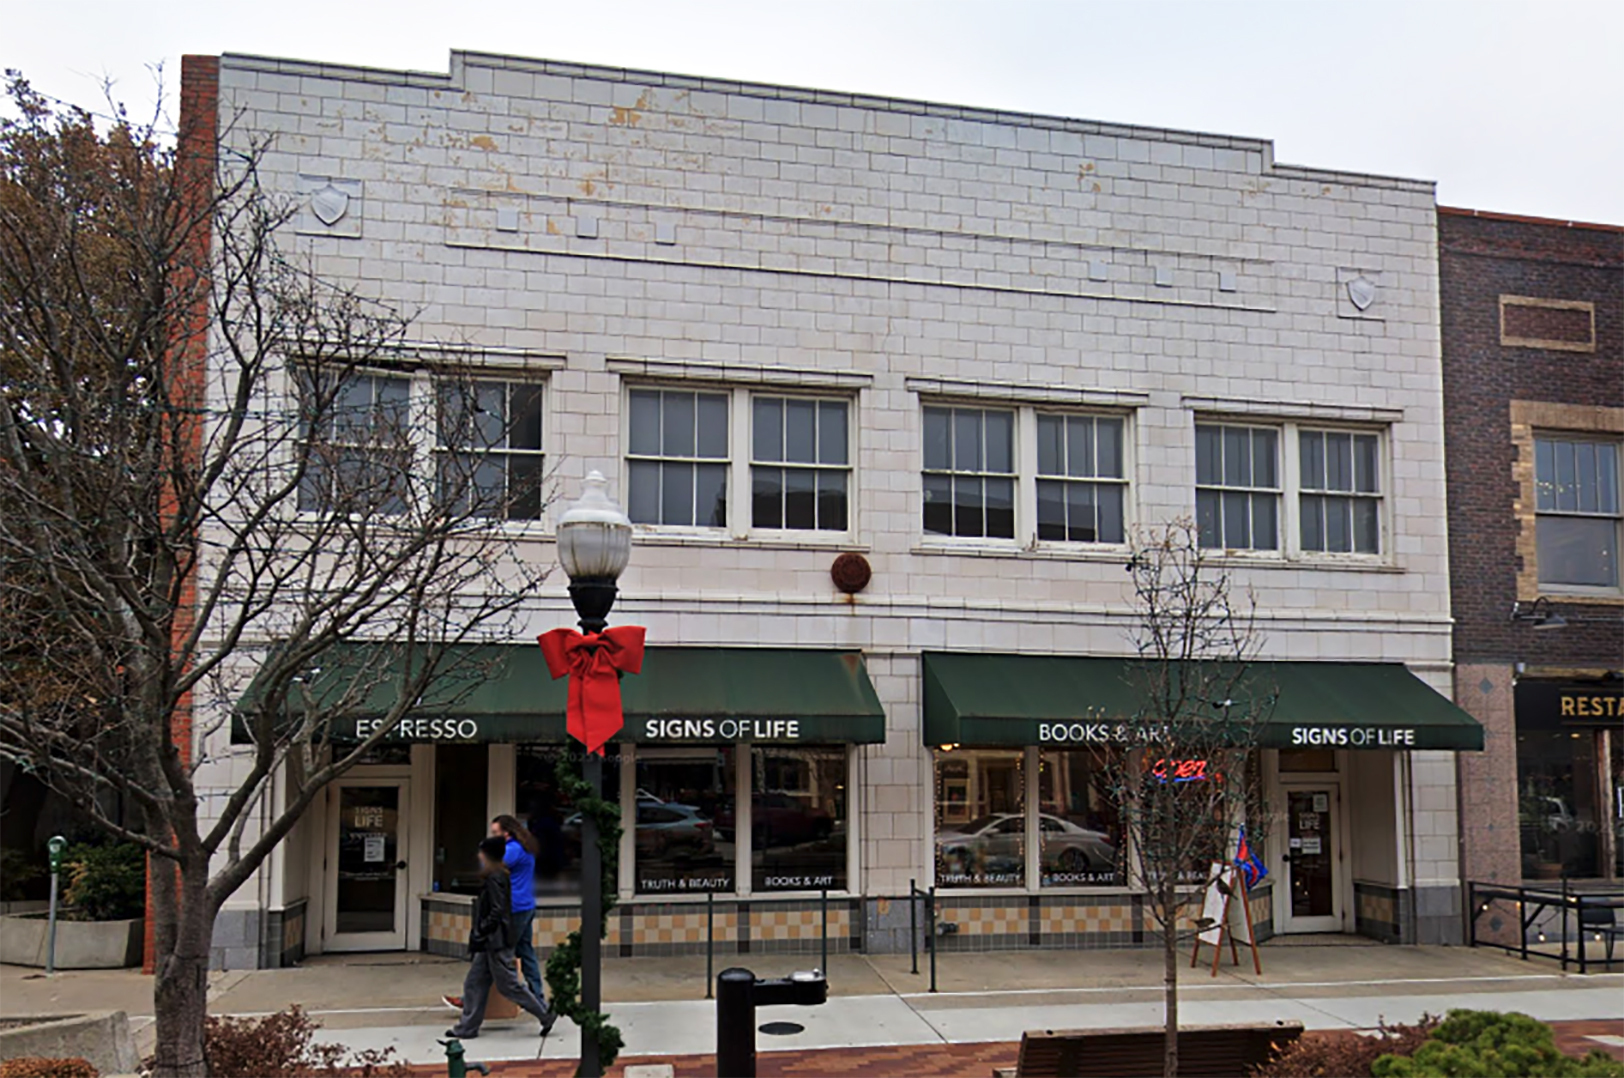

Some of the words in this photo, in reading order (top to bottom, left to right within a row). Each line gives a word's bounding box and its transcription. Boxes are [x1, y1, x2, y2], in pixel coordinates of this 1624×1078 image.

[645, 719, 715, 738] SIGNS
[719, 719, 751, 738] OF
[754, 720, 800, 738] LIFE
[1039, 724, 1110, 743] BOOKS
[1112, 724, 1128, 742] &
[1292, 727, 1347, 745] SIGNS
[1351, 728, 1375, 745] OF
[1378, 728, 1415, 745] LIFE
[354, 815, 383, 828] LIFE
[641, 878, 675, 889] TRUTH
[679, 878, 686, 889] &
[688, 877, 730, 889] BEAUTY
[765, 876, 801, 886] BOOKS
[803, 876, 811, 886] &
[813, 875, 834, 886] ART
[940, 873, 972, 883] TRUTH
[984, 873, 1021, 883] BEAUTY
[1052, 872, 1086, 882] BOOKS
[1088, 872, 1095, 882] &
[1096, 872, 1115, 882] ART
